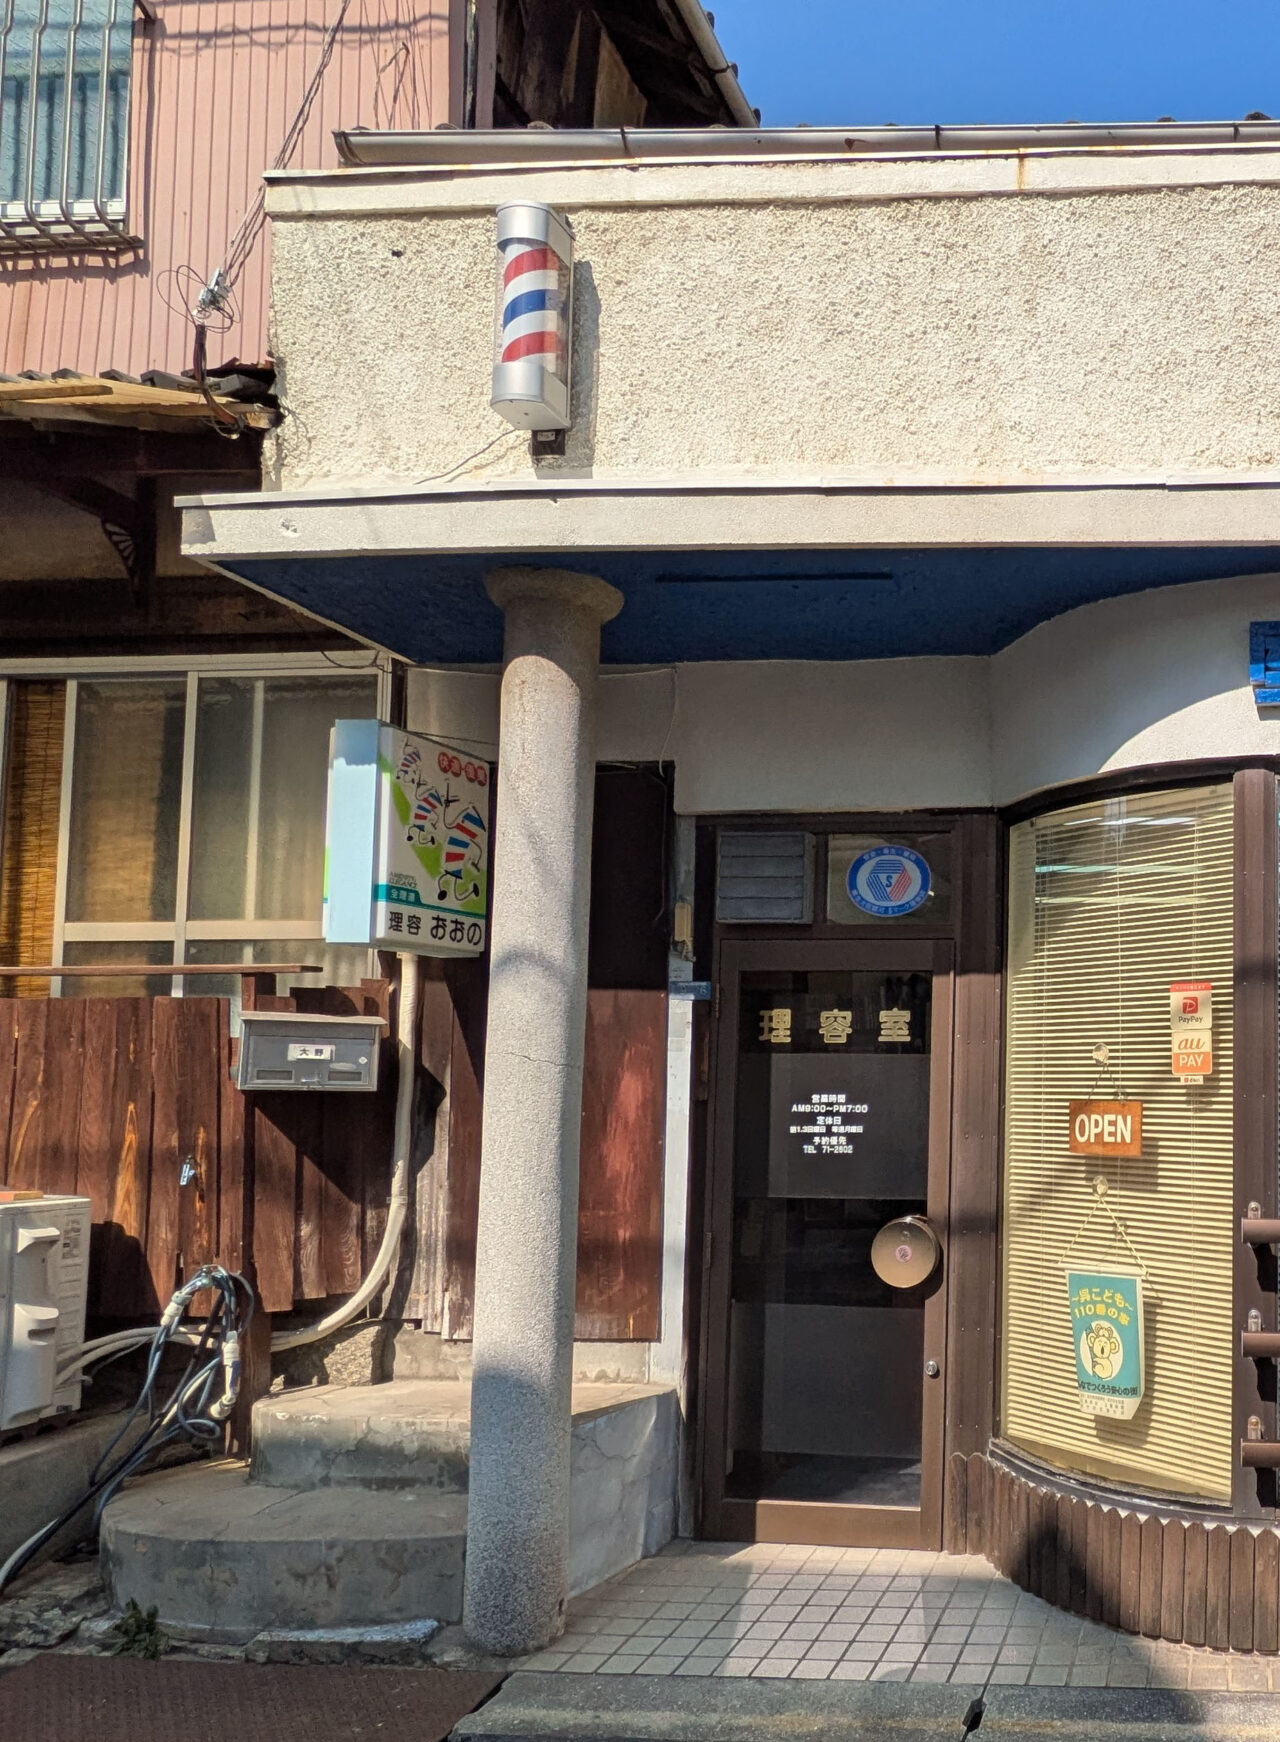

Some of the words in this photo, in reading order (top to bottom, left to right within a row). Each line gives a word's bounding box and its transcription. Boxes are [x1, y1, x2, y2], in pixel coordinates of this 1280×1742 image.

[389, 911, 421, 936] 理容
[430, 914, 482, 946] おおの
[1178, 1015, 1204, 1024] PayPay
[758, 1007, 912, 1044] 理容室
[1177, 1038, 1205, 1050] au
[299, 1047, 324, 1057] 大野
[1179, 1054, 1205, 1068] PAY
[811, 1094, 846, 1103] 営業時間
[816, 1116, 842, 1125] 定休日
[1074, 1113, 1132, 1144] OPEN
[812, 1136, 847, 1145] 予約優先
[803, 1145, 817, 1154] TEL
